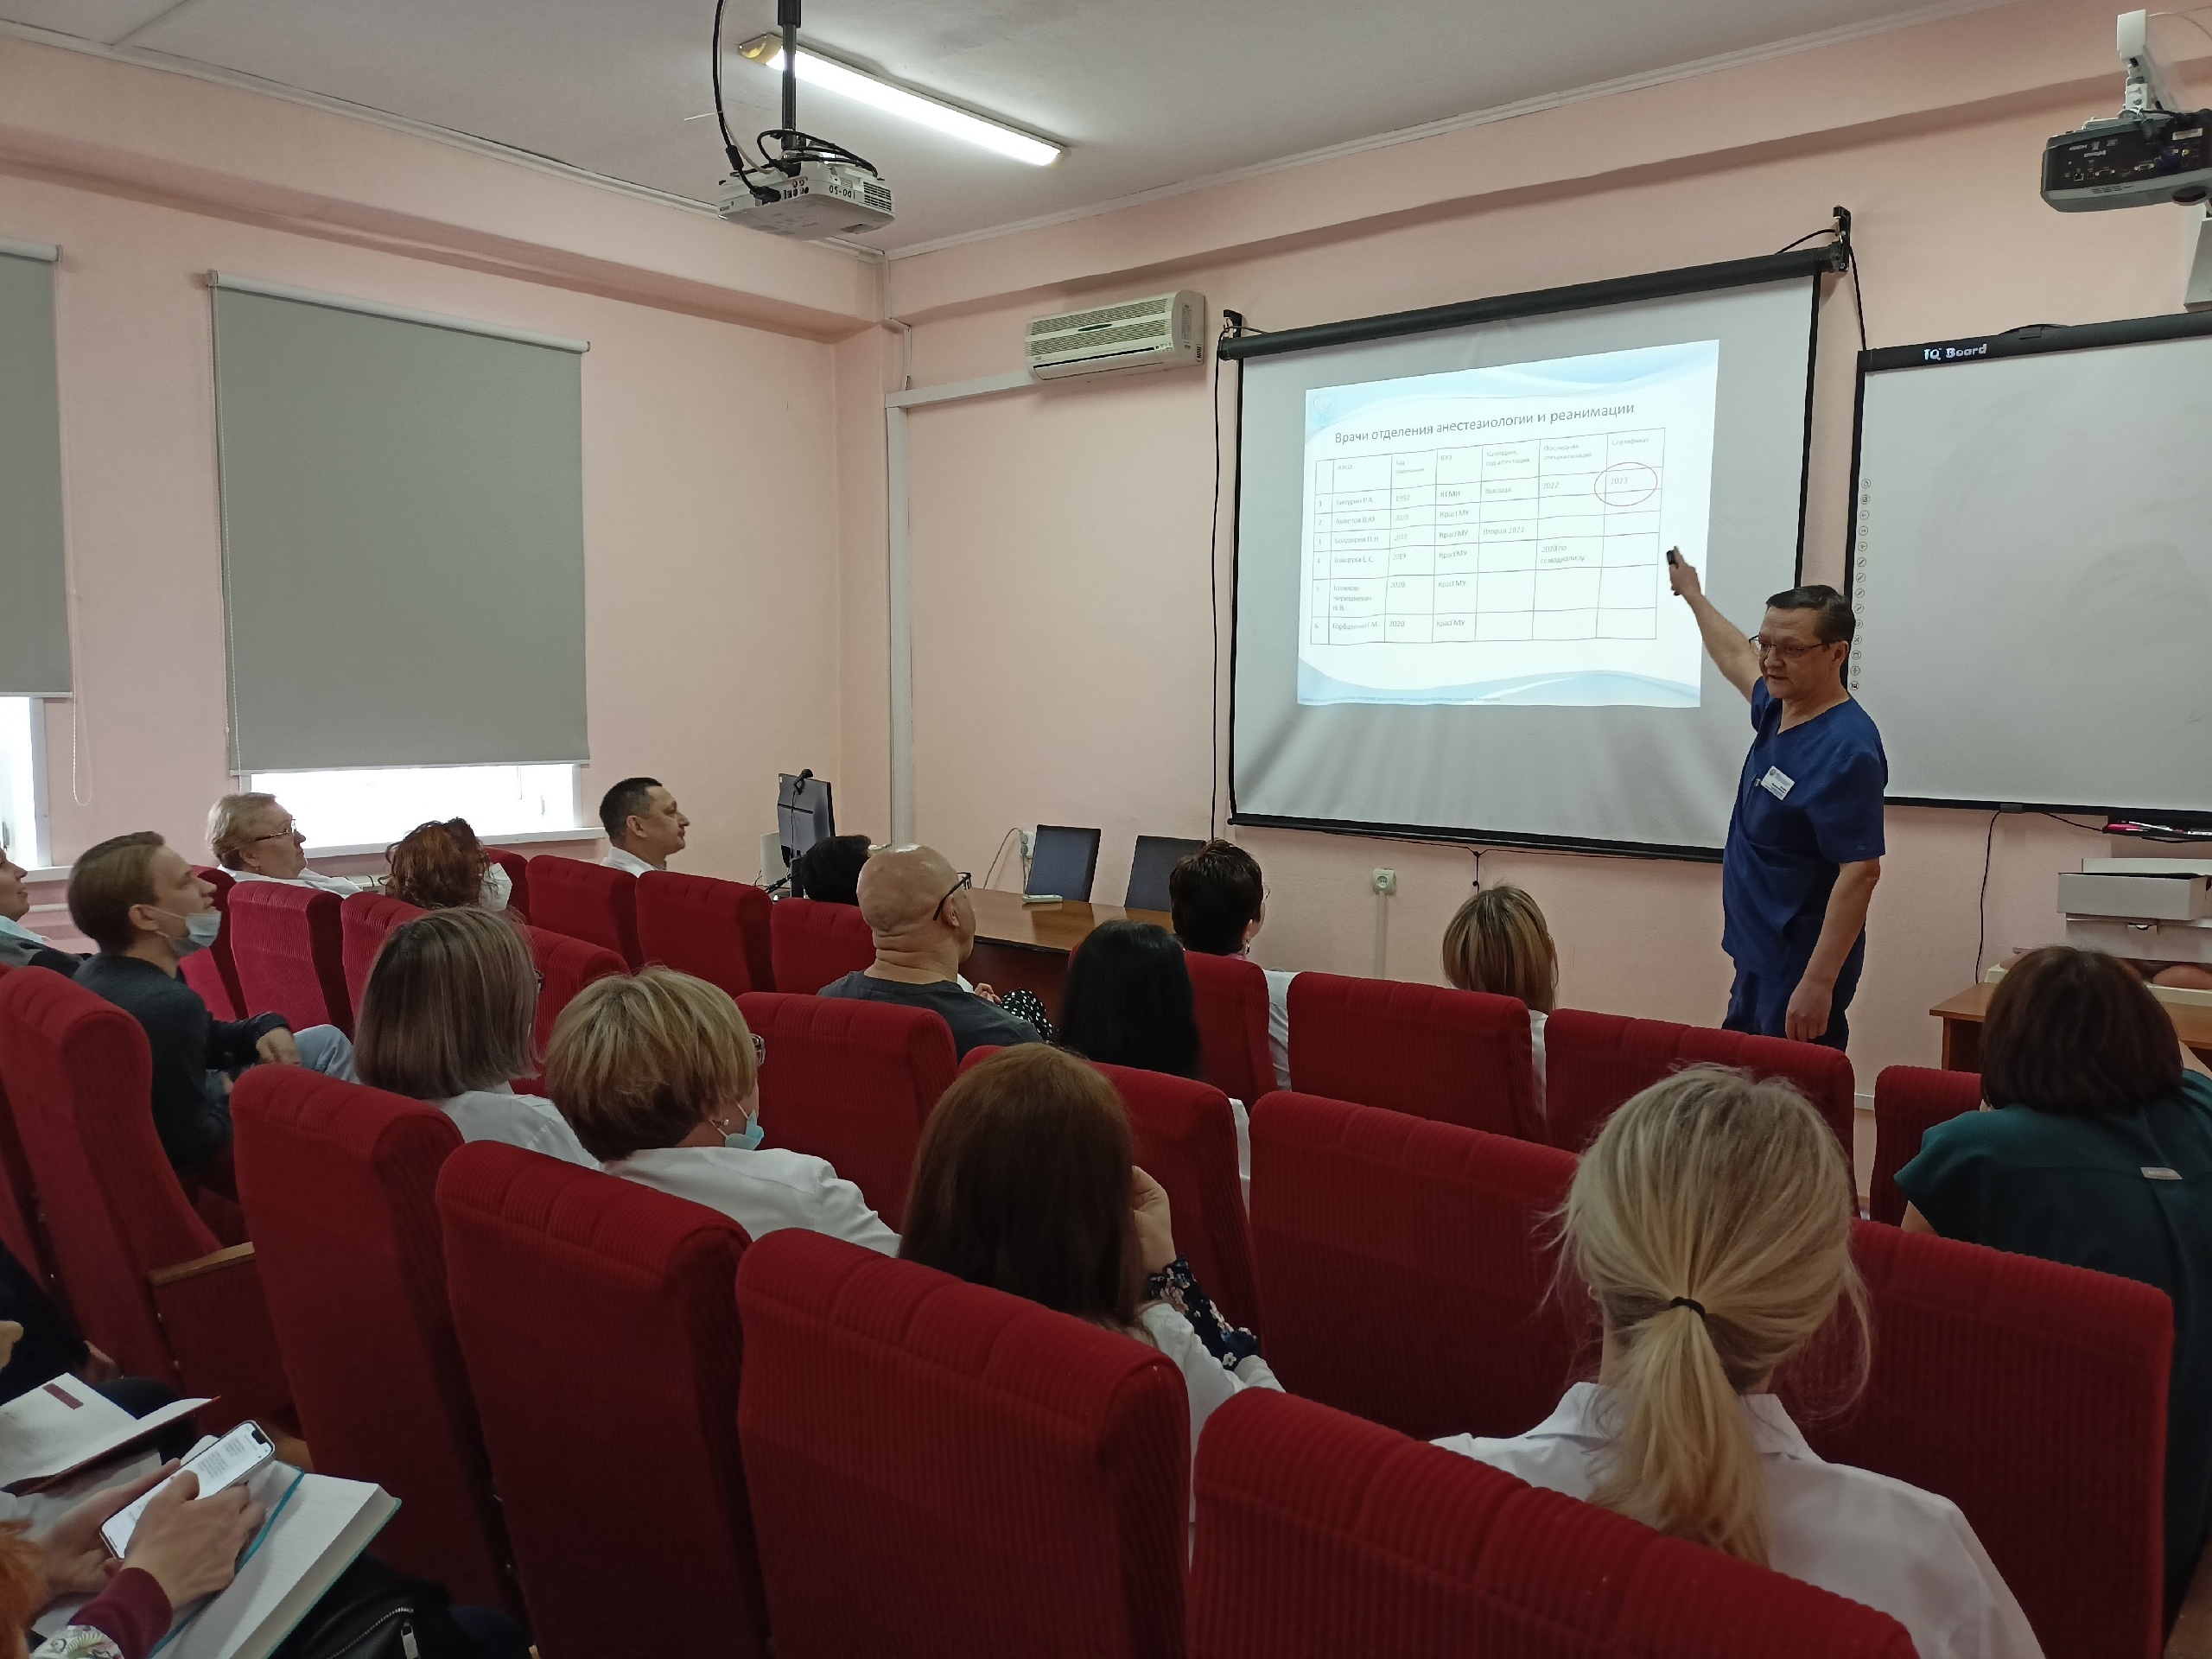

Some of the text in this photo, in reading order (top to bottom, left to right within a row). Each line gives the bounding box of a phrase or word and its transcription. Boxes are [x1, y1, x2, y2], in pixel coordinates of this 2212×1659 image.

[829, 184, 855, 200] 05-001
[1923, 343, 1987, 361] IQ Board
[1335, 404, 1635, 444] Врачи отделения анестезиологии и реанимации
[1542, 481, 1560, 490] 2022
[1440, 509, 1469, 518] КрасГМУ
[1439, 529, 1469, 539] КрасГМУ
[1483, 528, 1507, 537] Вторая
[1438, 550, 1467, 559] КрасГМУ
[1438, 580, 1467, 588] КрасГМУ
[1436, 619, 1466, 627] КрасГМУ
